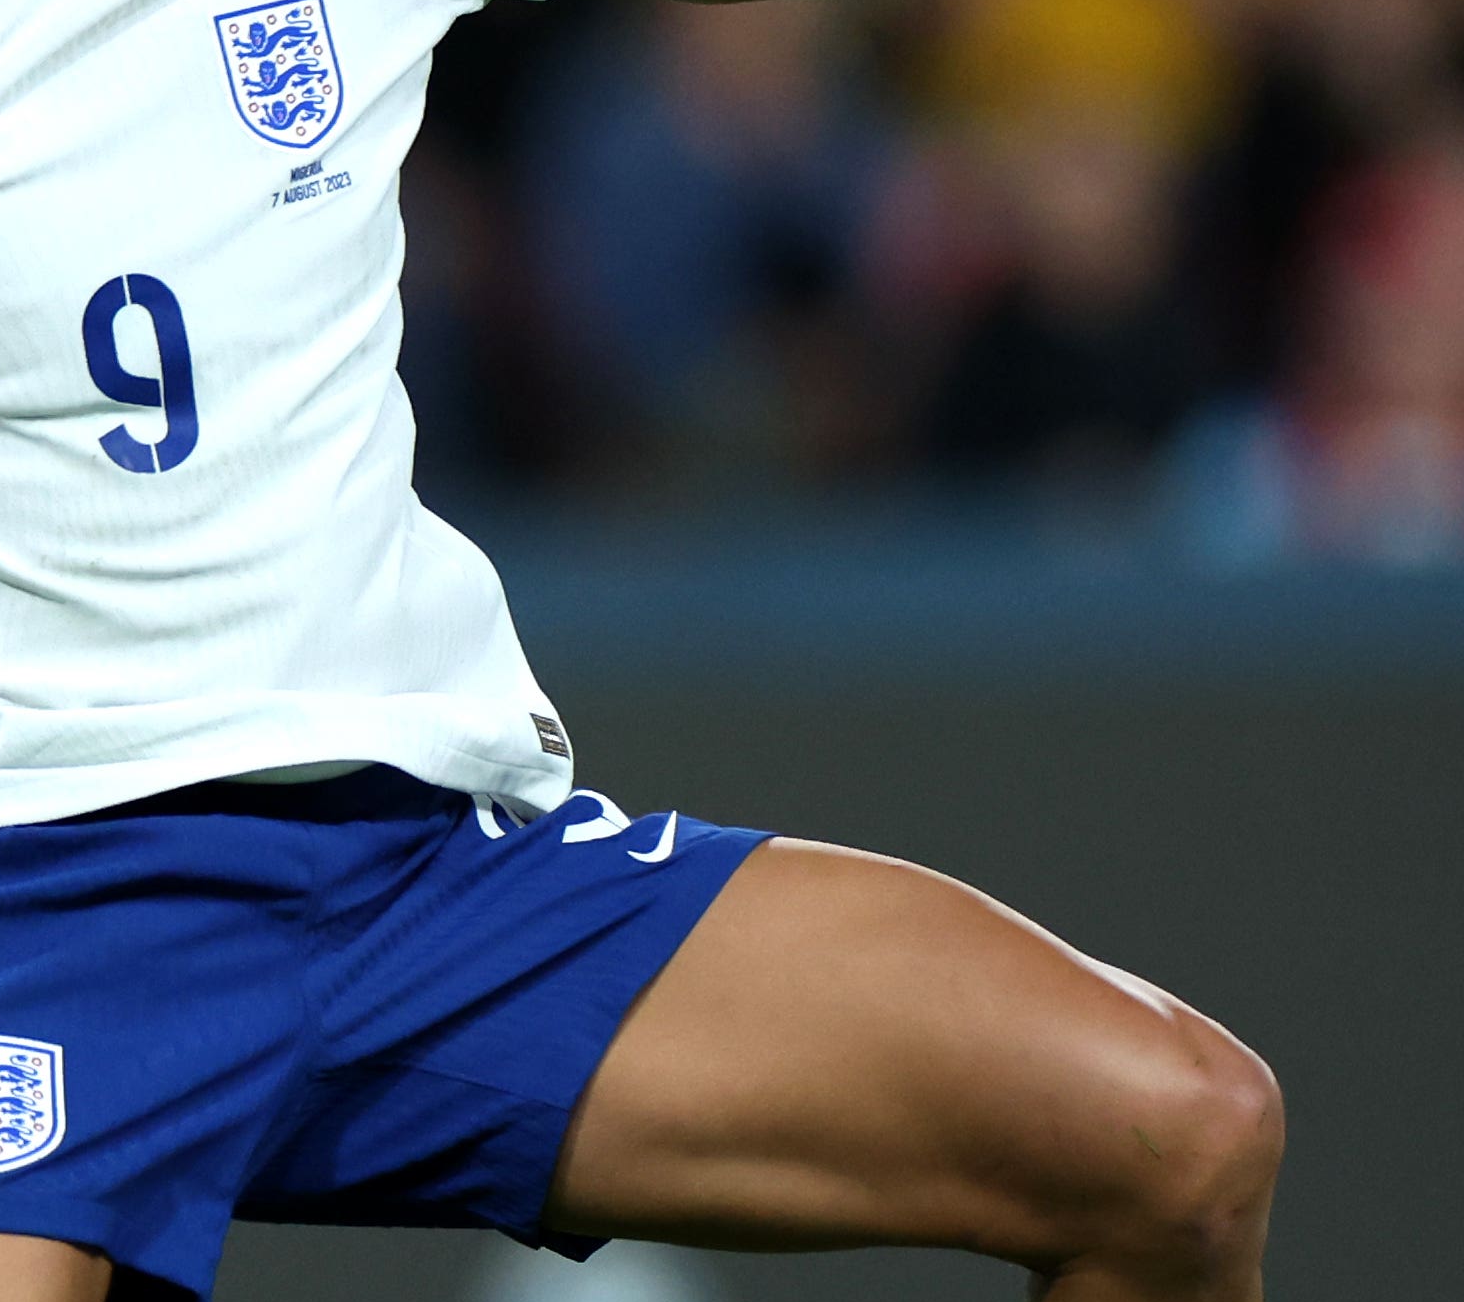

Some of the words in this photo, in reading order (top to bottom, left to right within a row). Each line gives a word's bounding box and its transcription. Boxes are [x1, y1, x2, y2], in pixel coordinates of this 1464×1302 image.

[272, 191, 280, 208] 7
[284, 181, 322, 204] AUGUST
[324, 172, 351, 192] 2023
[82, 273, 199, 474] 9
